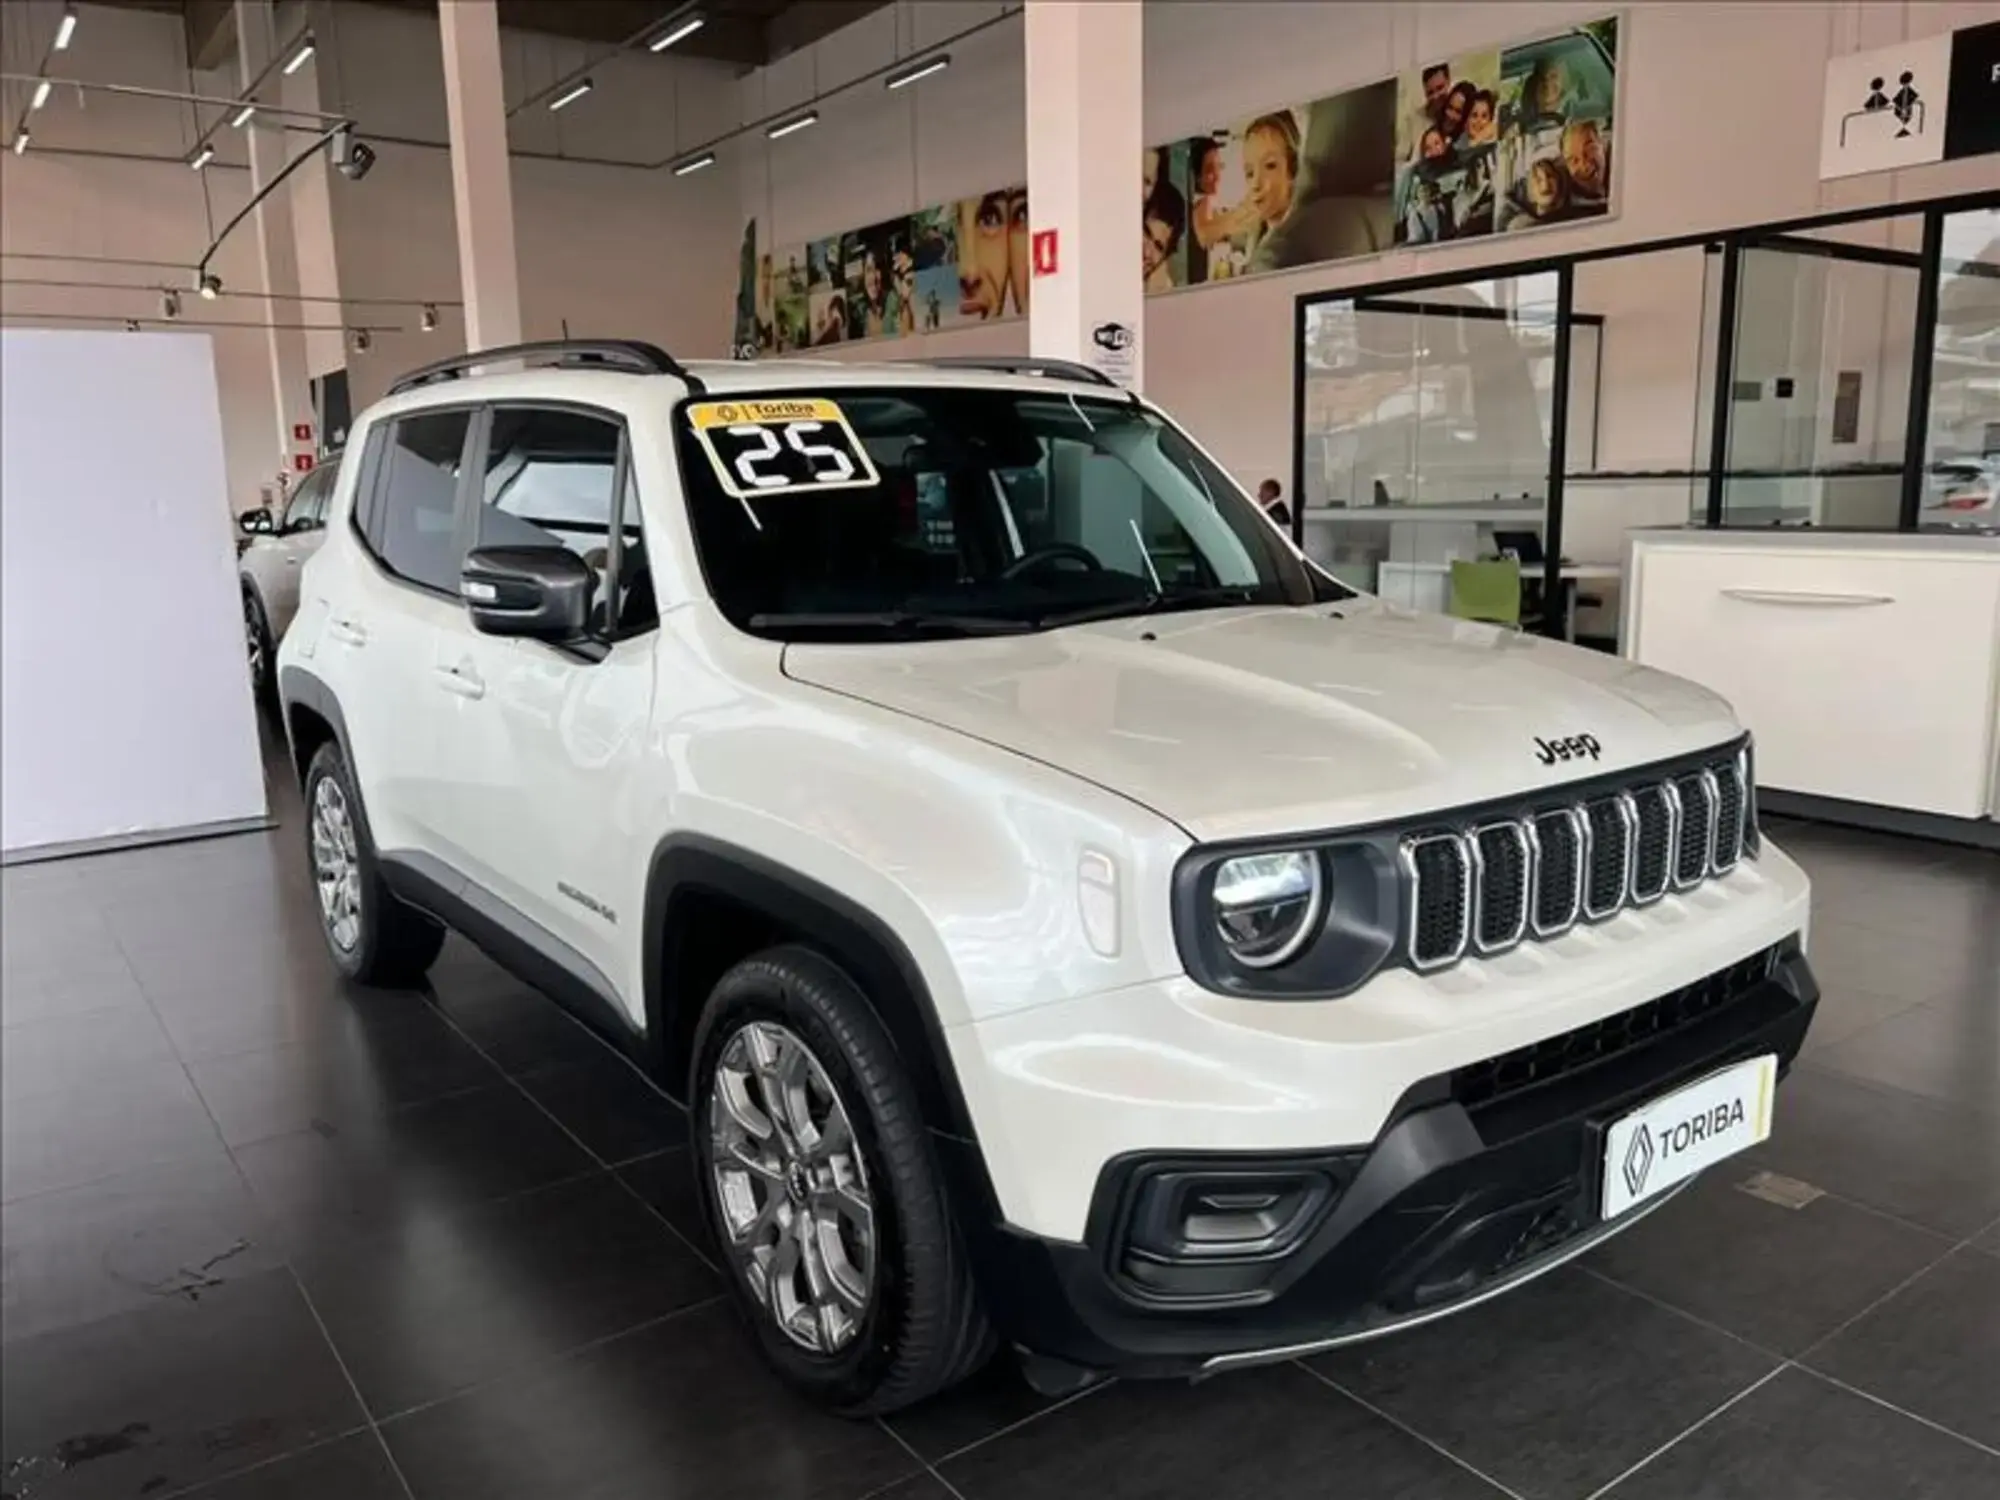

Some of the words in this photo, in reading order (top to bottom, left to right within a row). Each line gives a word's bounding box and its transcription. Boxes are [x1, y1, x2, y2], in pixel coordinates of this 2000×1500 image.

[751, 402, 815, 414] Toriba
[727, 422, 855, 487] 25
[1533, 734, 1601, 765] Jeep
[1660, 1097, 1744, 1159] TORIBA
